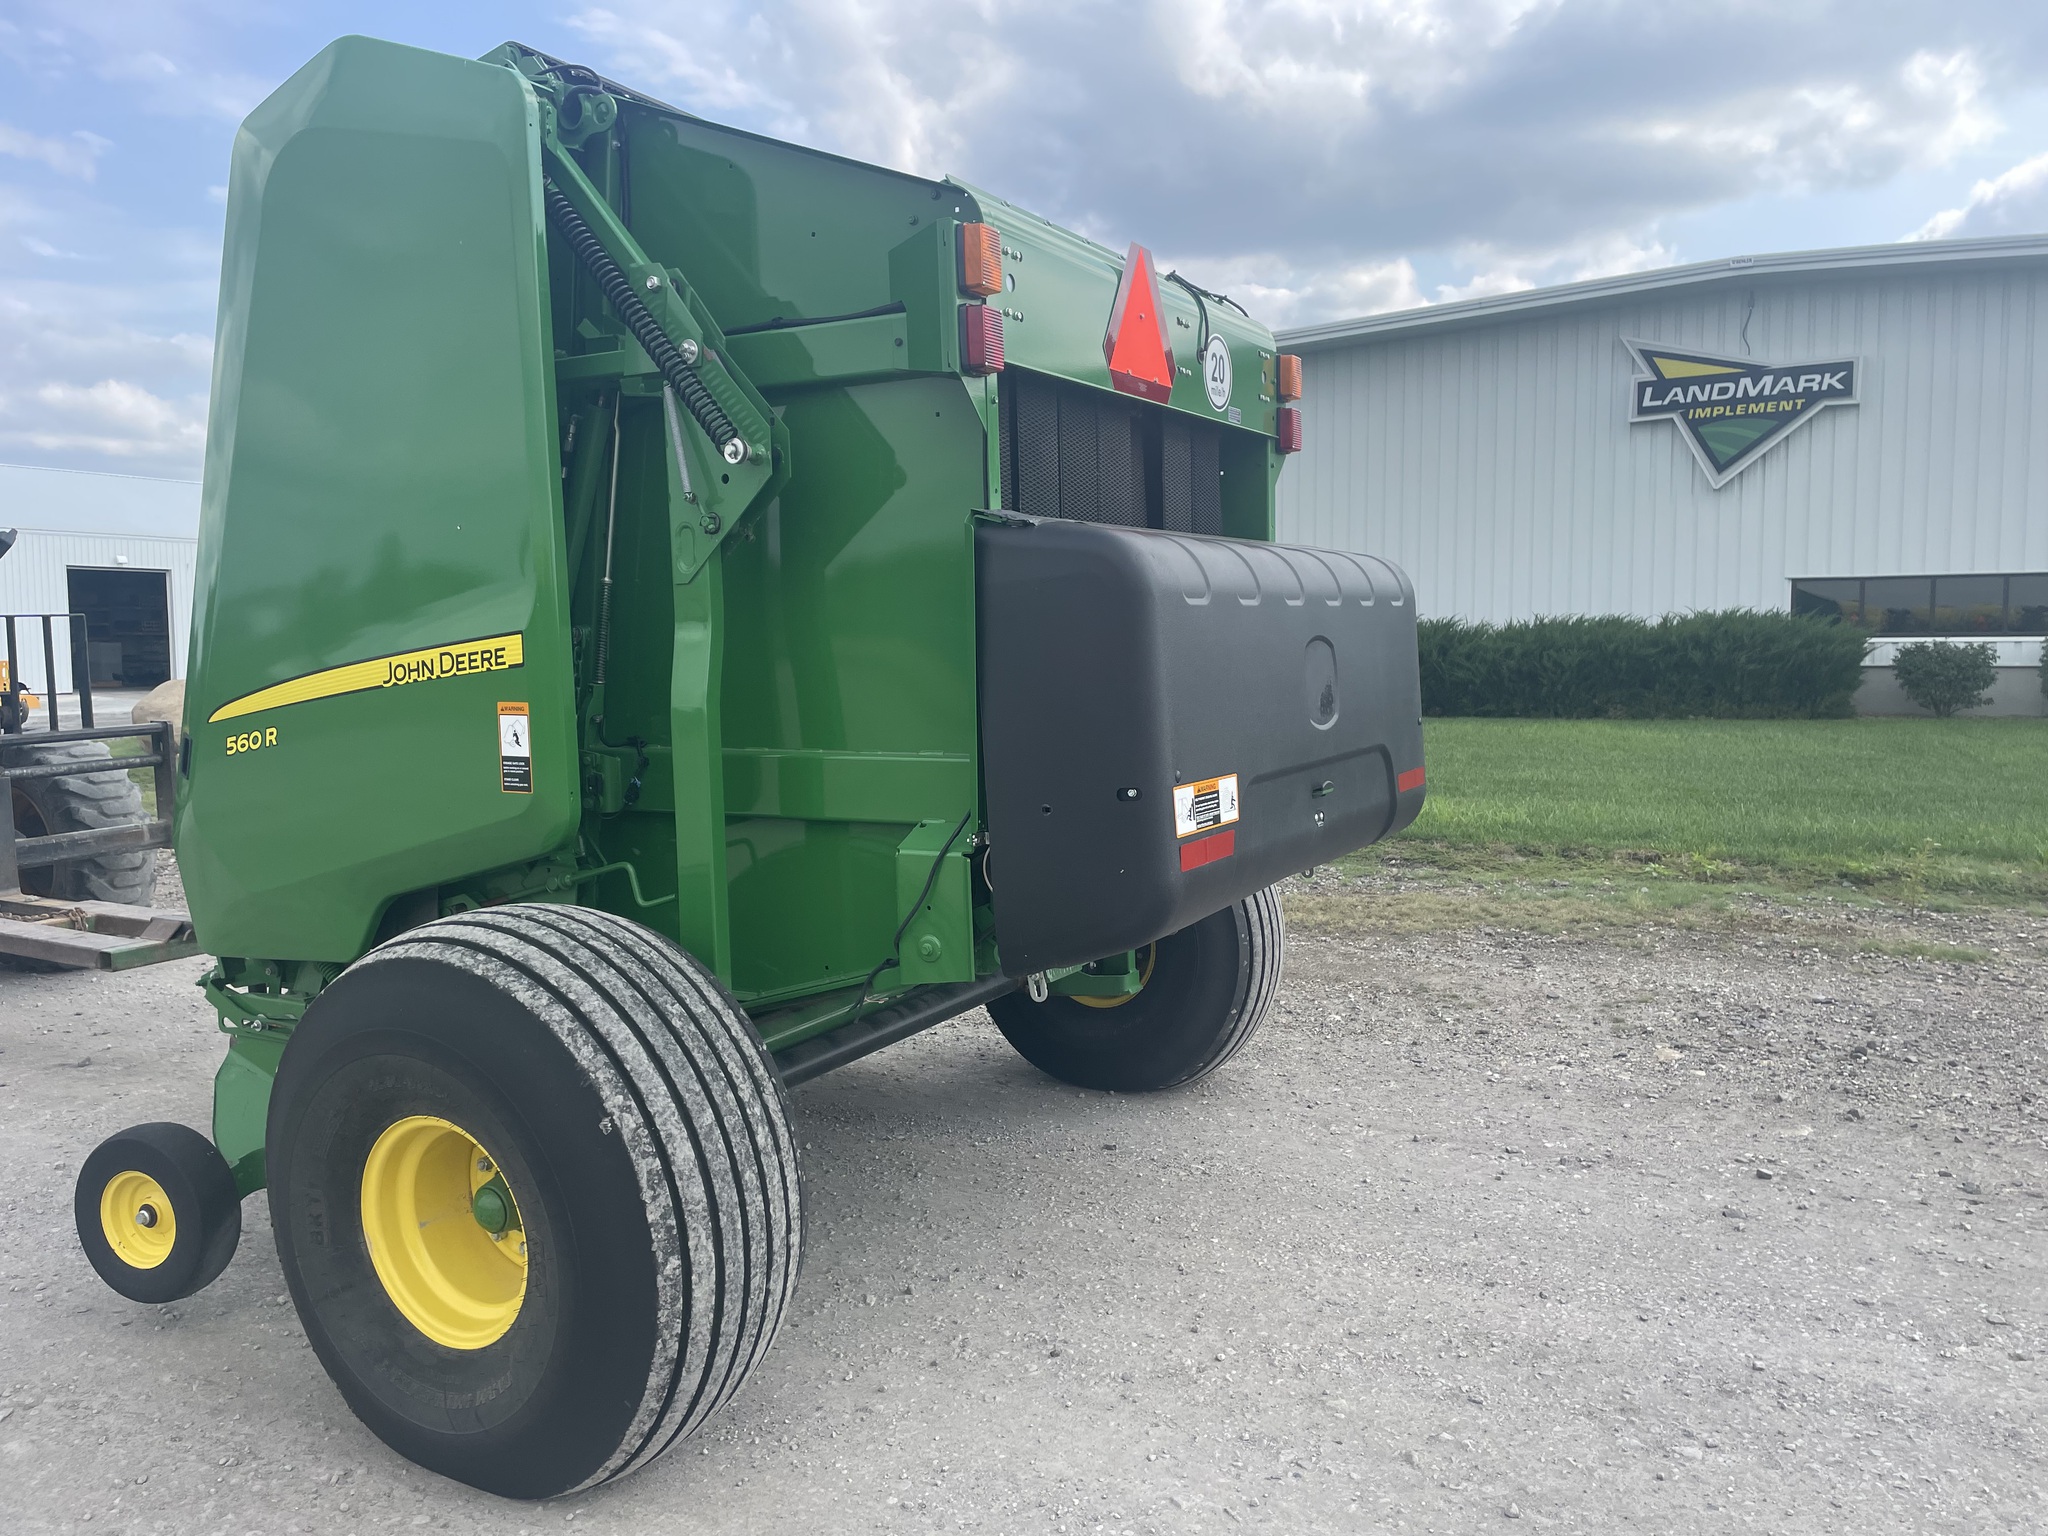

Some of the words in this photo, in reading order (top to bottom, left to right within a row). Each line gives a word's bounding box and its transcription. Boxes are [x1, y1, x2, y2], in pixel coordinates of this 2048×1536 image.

[1211, 352, 1225, 385] 20
[1642, 371, 1848, 407] LANDMARK
[1688, 399, 1806, 420] IMPLEMENT
[383, 658, 434, 685] JOHN
[439, 647, 506, 675] DEERE
[226, 730, 262, 756] 560
